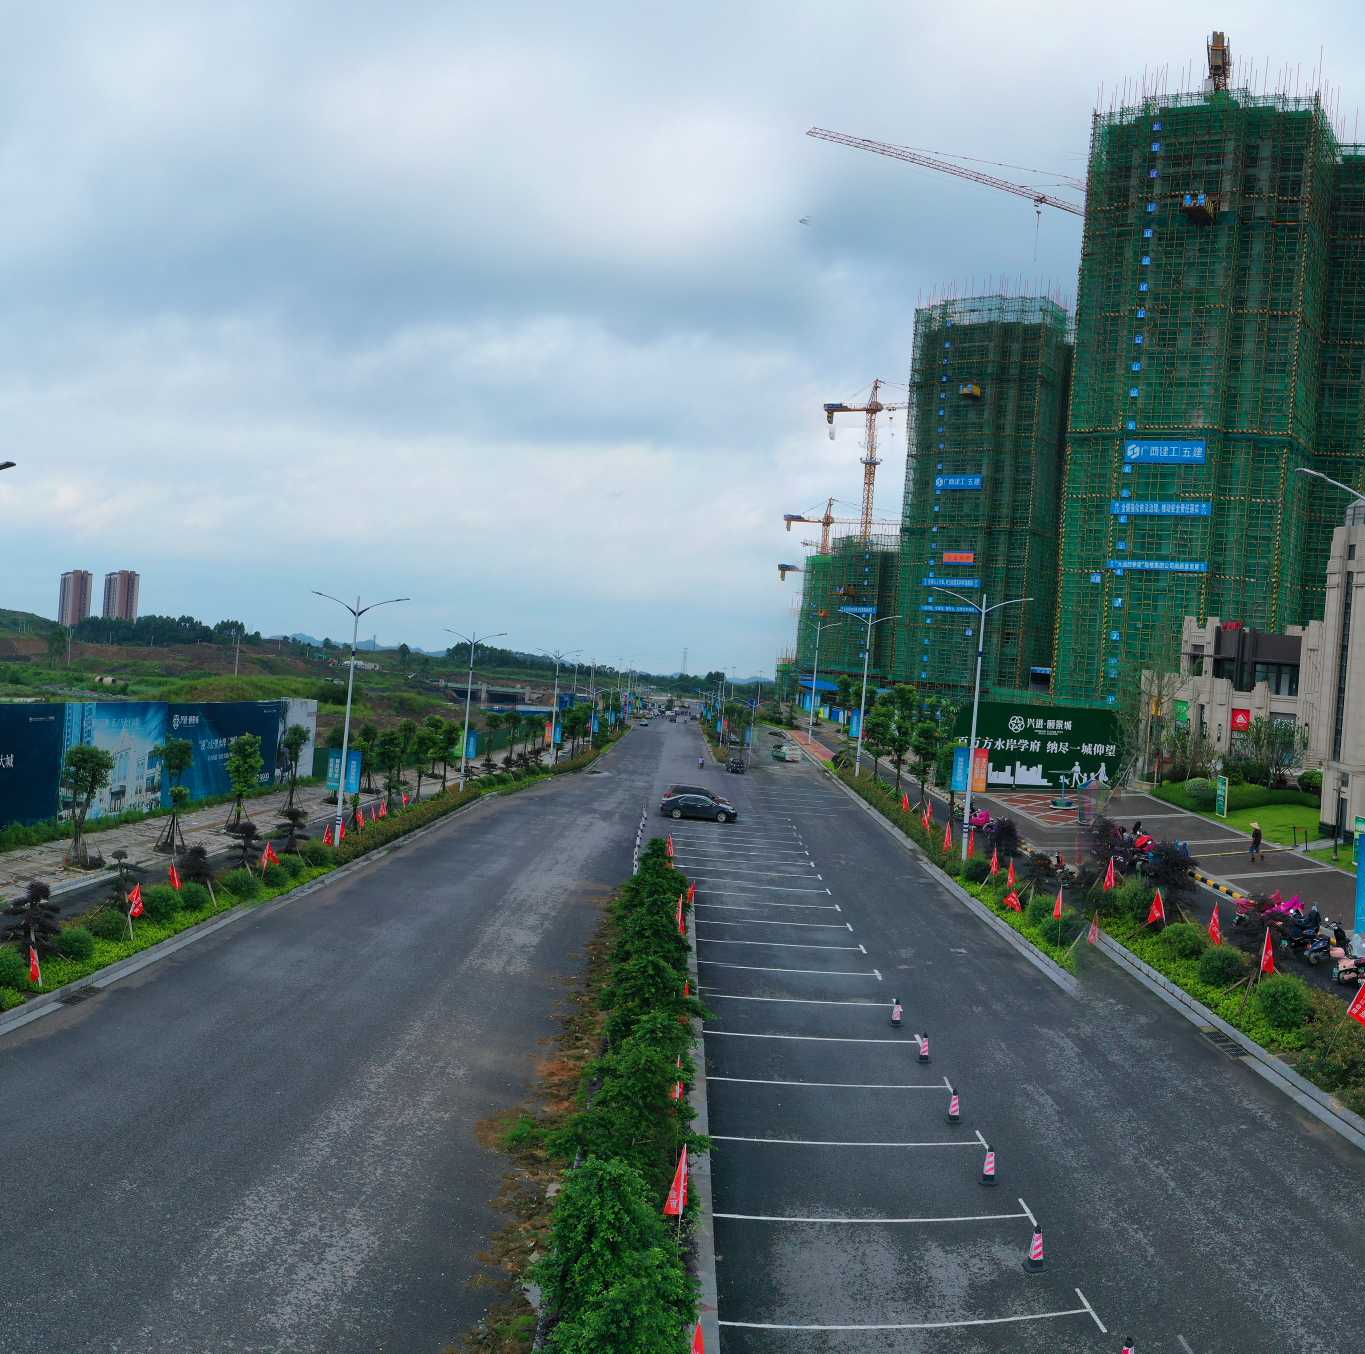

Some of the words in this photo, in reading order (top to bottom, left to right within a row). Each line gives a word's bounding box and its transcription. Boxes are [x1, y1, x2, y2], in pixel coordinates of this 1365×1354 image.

[1026, 718, 1073, 731] 兴进·颐景城
[1046, 740, 1117, 757] 纳尽一城仰望
